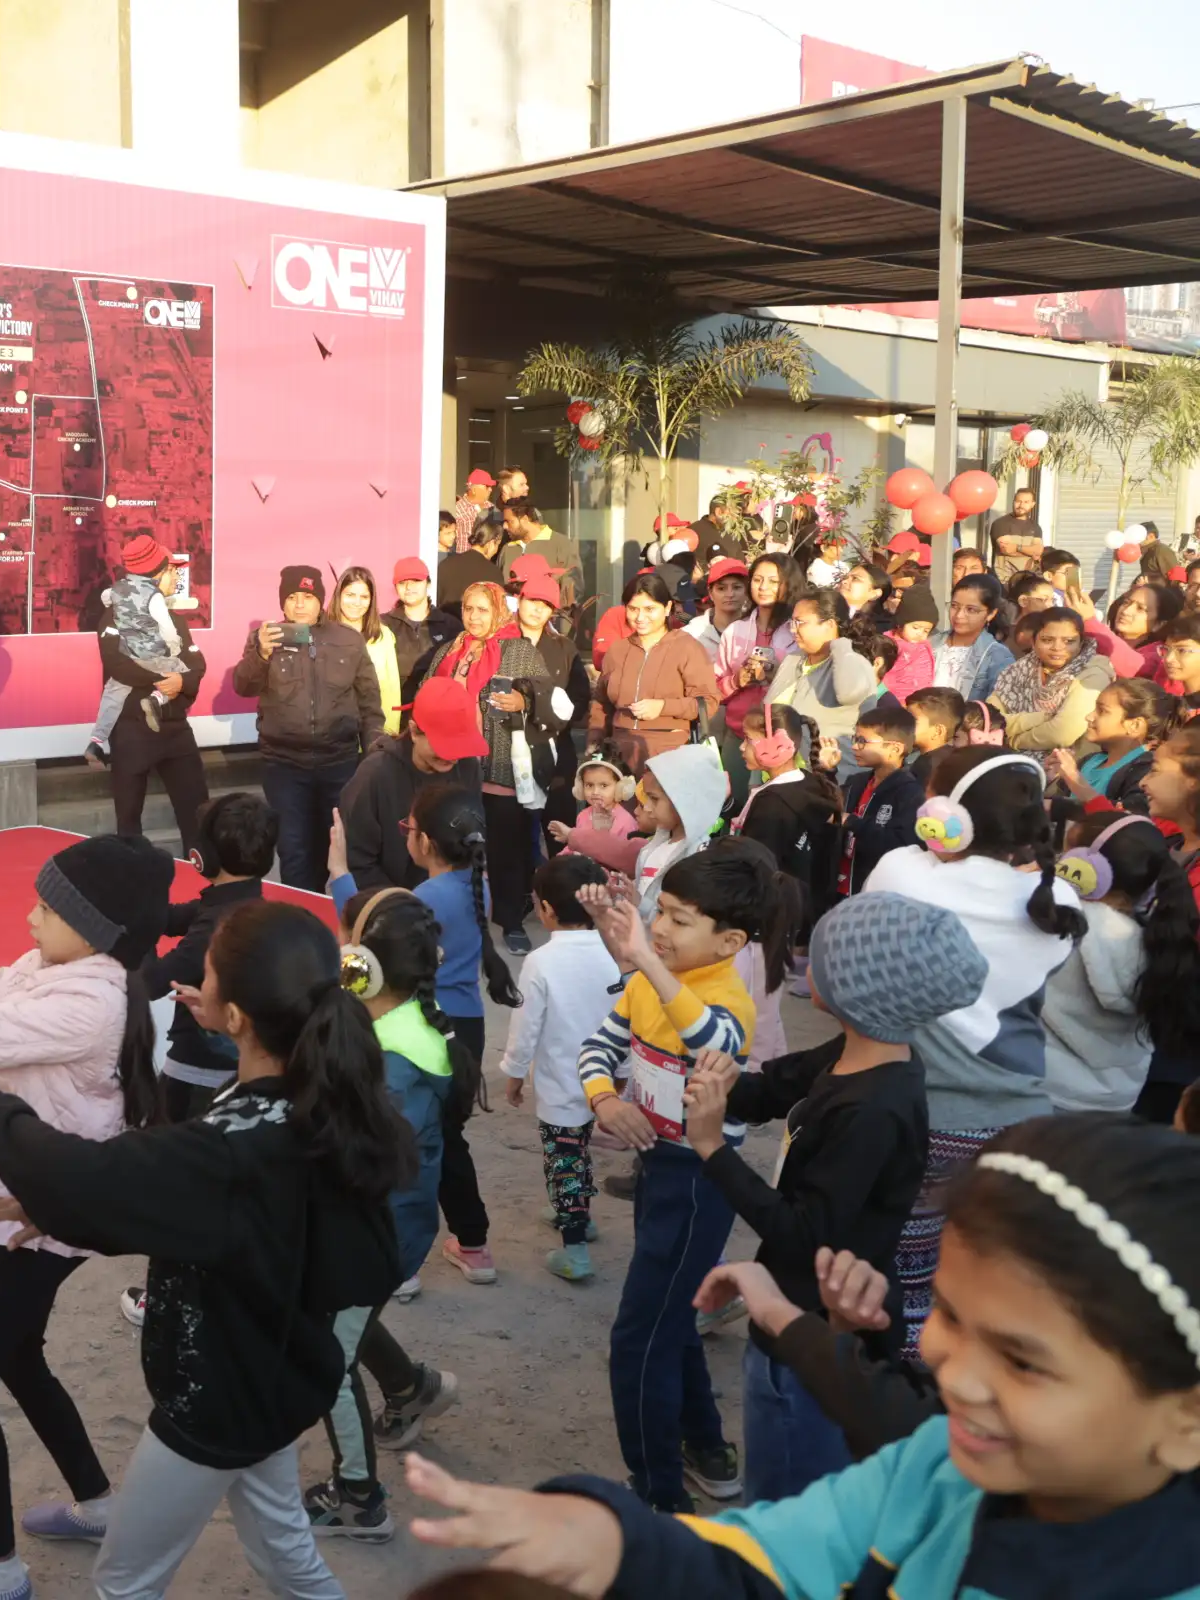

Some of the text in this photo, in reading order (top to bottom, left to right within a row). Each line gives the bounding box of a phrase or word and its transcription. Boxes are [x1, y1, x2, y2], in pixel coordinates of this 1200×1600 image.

[274, 242, 368, 311] ONE
[369, 289, 405, 307] VIHAV
[144, 299, 184, 327] ONE
[8, 348, 14, 357] 3
